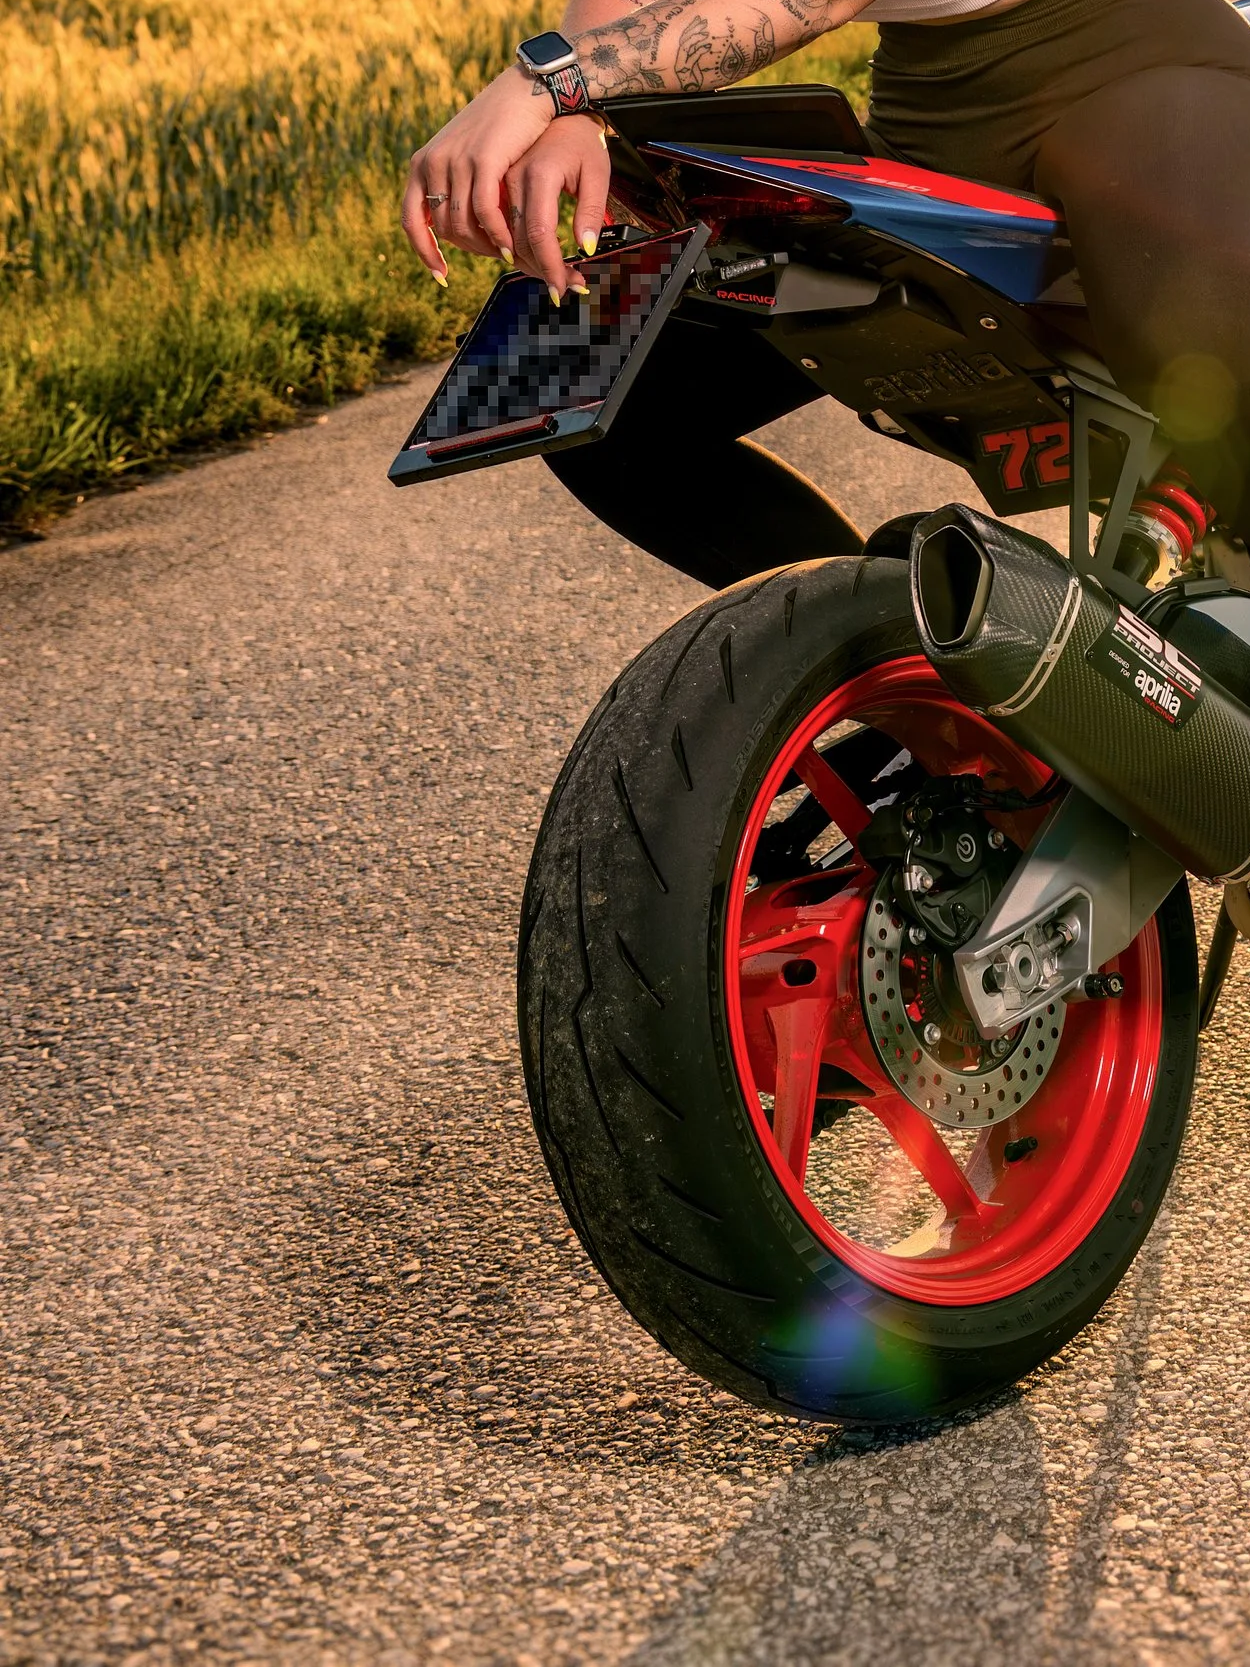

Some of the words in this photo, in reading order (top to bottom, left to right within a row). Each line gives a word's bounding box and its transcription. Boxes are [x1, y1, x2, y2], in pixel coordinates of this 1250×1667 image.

[716, 290, 778, 308] RACING
[864, 349, 1016, 404] aprilia
[980, 421, 1070, 491] 72
[1112, 622, 1201, 694] PROJECT
[1120, 667, 1131, 678] FOR
[1134, 669, 1181, 717] aprilia
[1143, 696, 1176, 724] RACING
